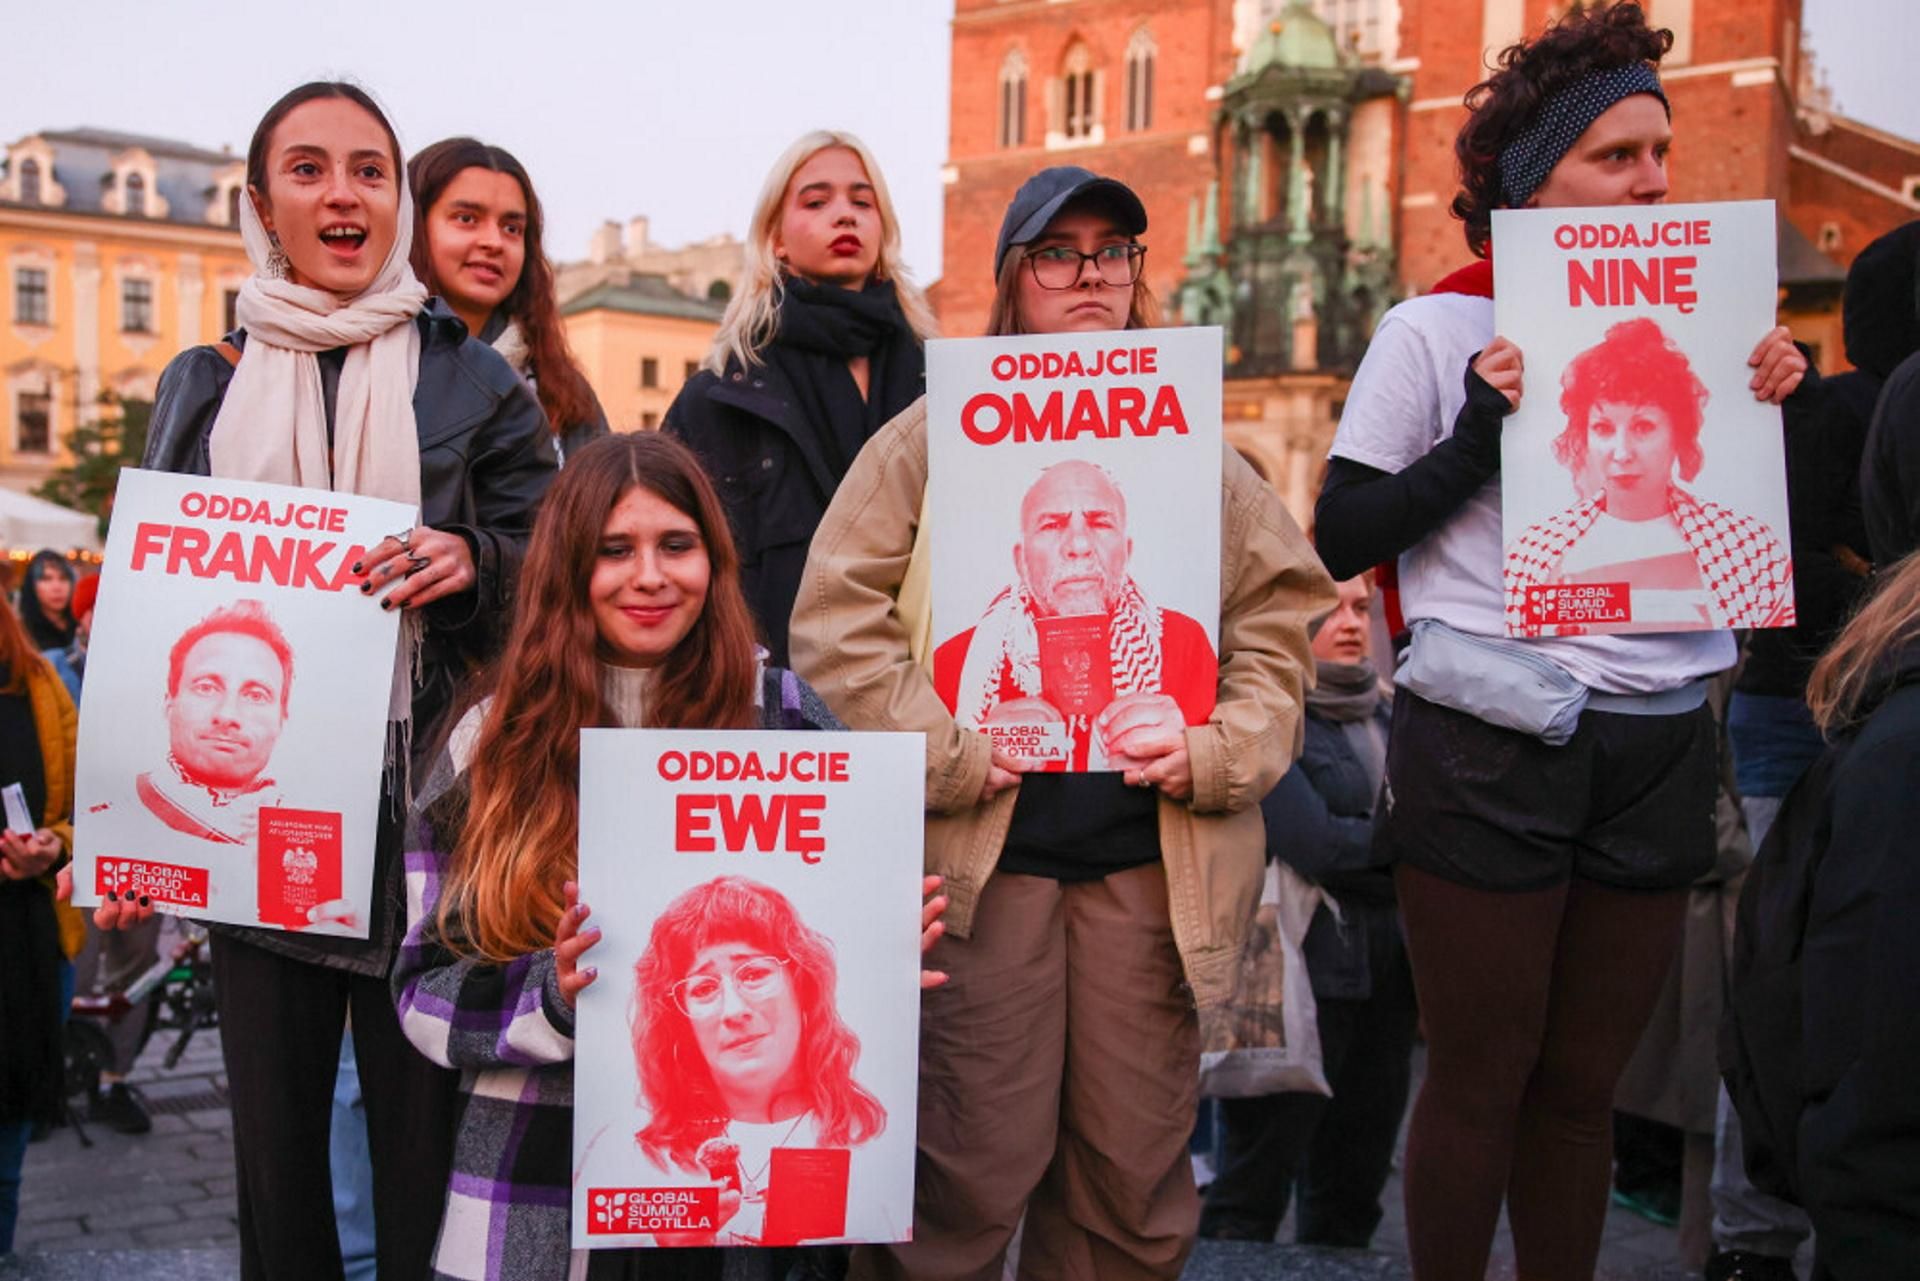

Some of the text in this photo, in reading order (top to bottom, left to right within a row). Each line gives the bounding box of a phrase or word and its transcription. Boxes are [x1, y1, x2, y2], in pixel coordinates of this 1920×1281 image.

[1554, 220, 1711, 249] ODDAJCIE
[1567, 256, 1698, 314] NINĘ
[992, 347, 1158, 381] ODDAJCIE
[961, 385, 1190, 446] OMARA
[180, 492, 349, 533] ODDAJCIE
[1558, 587, 1615, 599] GLOBAL
[1558, 598, 1606, 610] SUMUD
[1558, 607, 1625, 620] FLOTILLA
[991, 726, 1050, 737] GLOBAL
[992, 736, 1041, 748] SUMUD
[1007, 746, 1060, 757] OTILLA
[657, 750, 850, 782] ODDAJCIE
[675, 794, 826, 864] EWĘ
[131, 863, 193, 881] GLOBAL
[131, 873, 182, 891] SUMUD
[628, 1192, 700, 1204] GLOBAL
[628, 1204, 688, 1217] SUMUD
[627, 1216, 711, 1229] FLOTILLA
